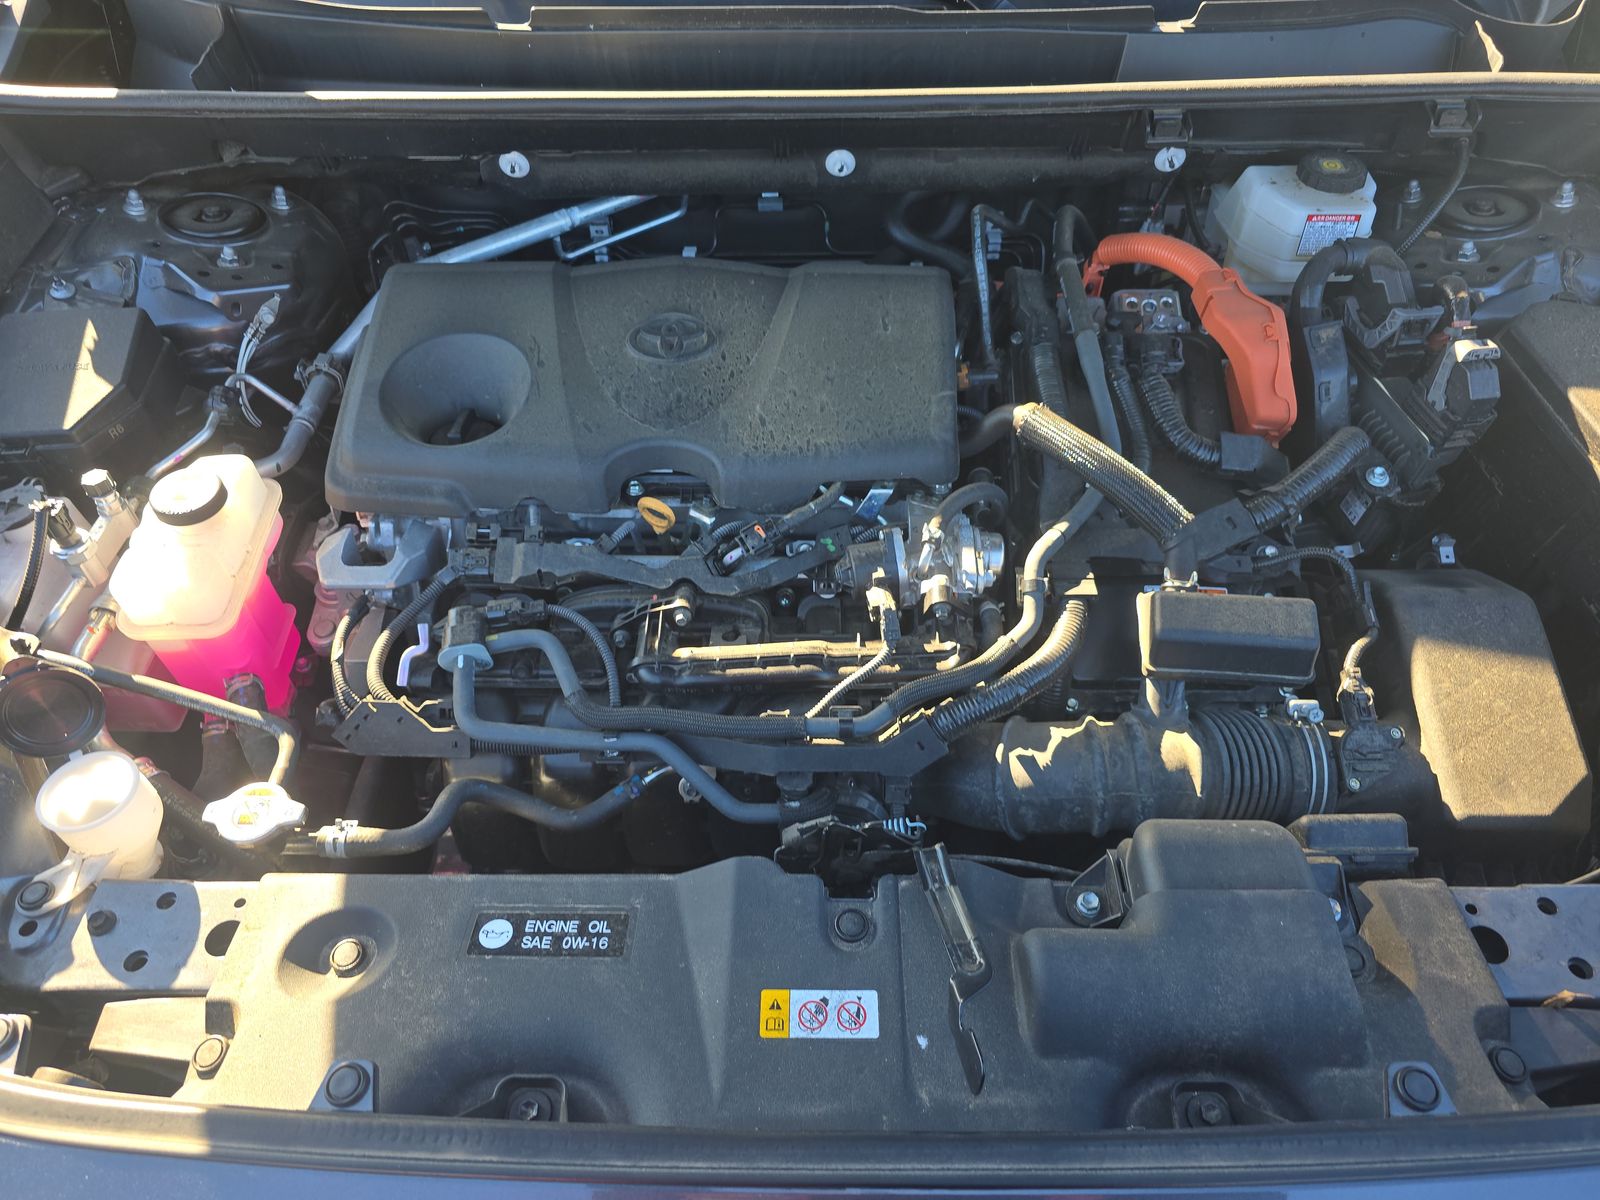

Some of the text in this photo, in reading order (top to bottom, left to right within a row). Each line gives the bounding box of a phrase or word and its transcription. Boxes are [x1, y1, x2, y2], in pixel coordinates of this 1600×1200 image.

[525, 920, 611, 933] ENGINE OIL
[521, 936, 609, 949] SAE 0W-16
